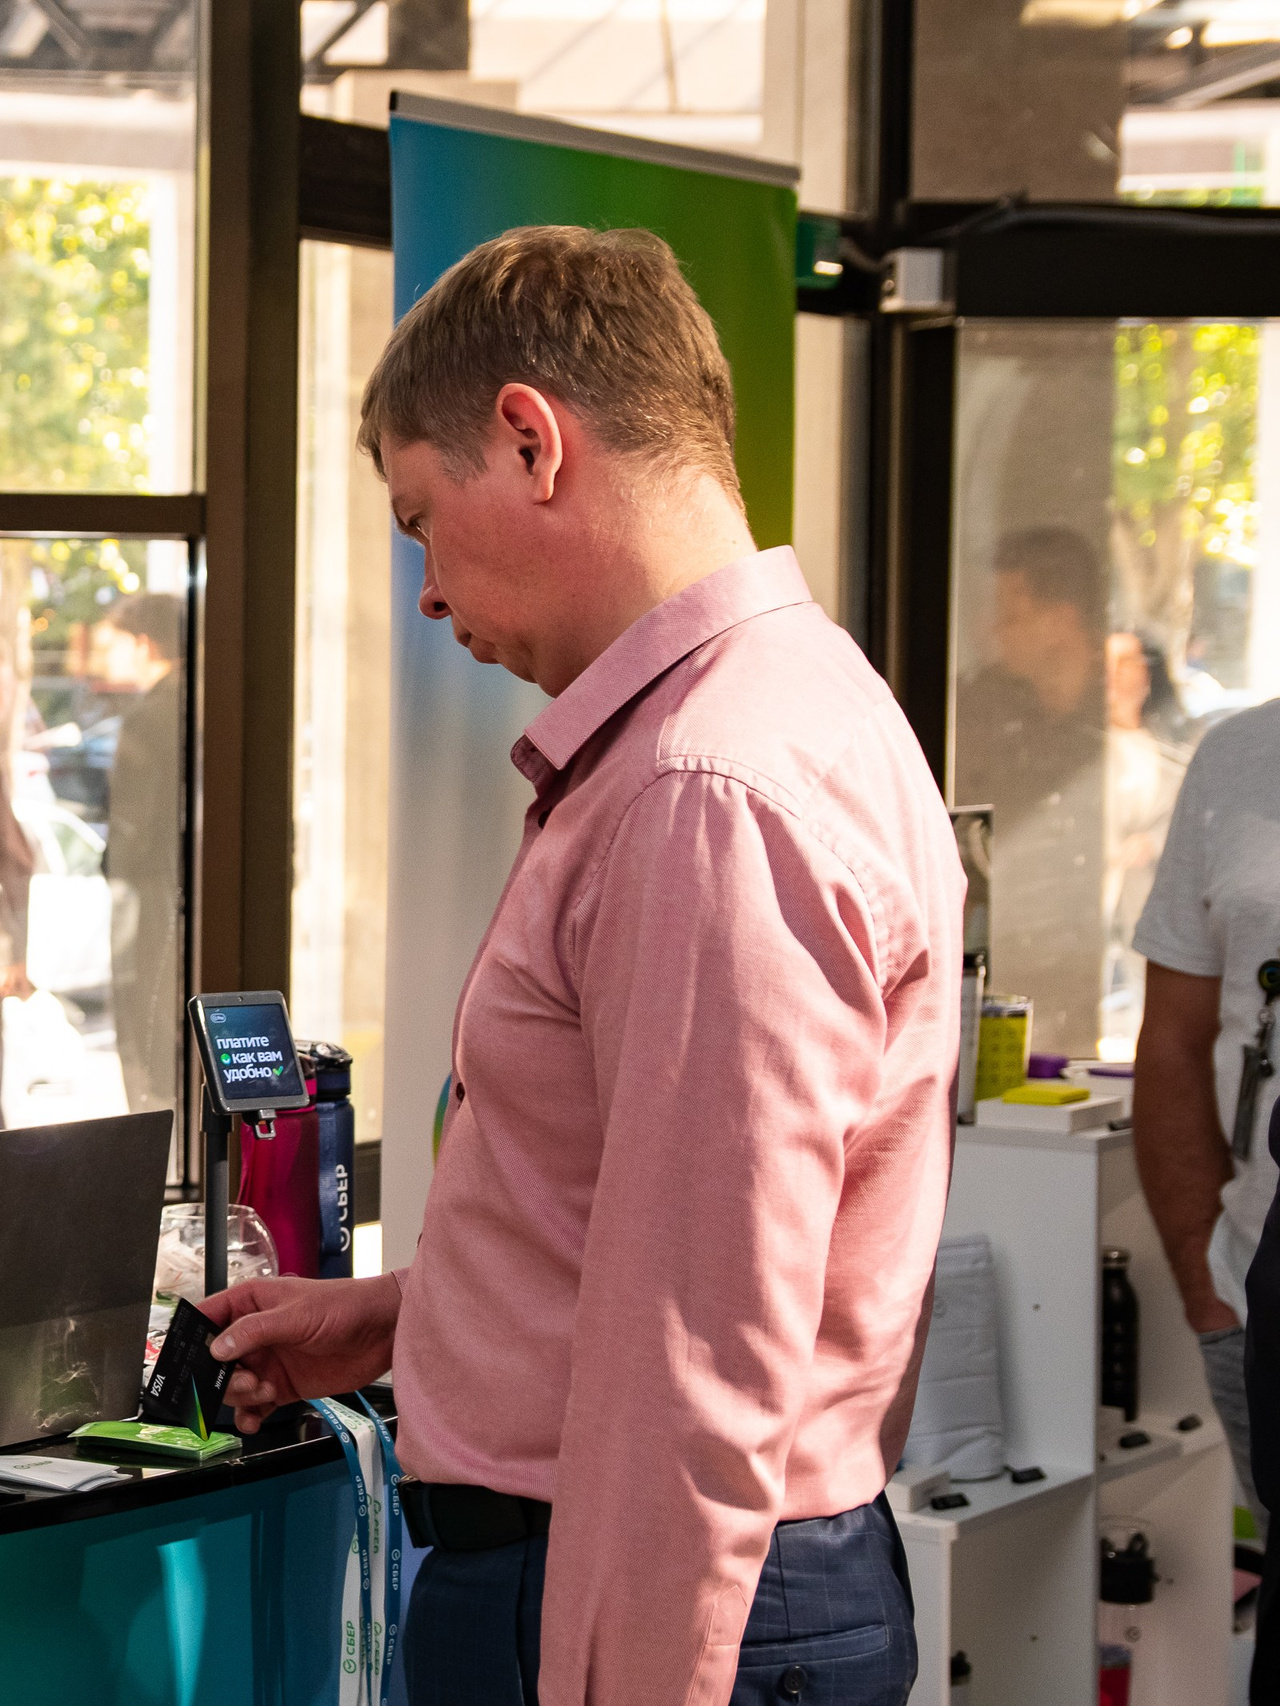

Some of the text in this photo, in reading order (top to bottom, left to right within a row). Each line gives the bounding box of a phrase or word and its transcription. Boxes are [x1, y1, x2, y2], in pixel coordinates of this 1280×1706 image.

[216, 1036, 270, 1050] платите
[232, 1051, 283, 1064] как вам
[223, 1063, 272, 1084] удобно
[150, 1373, 166, 1397] VISA
[346, 1620, 356, 1656] СБЕР
